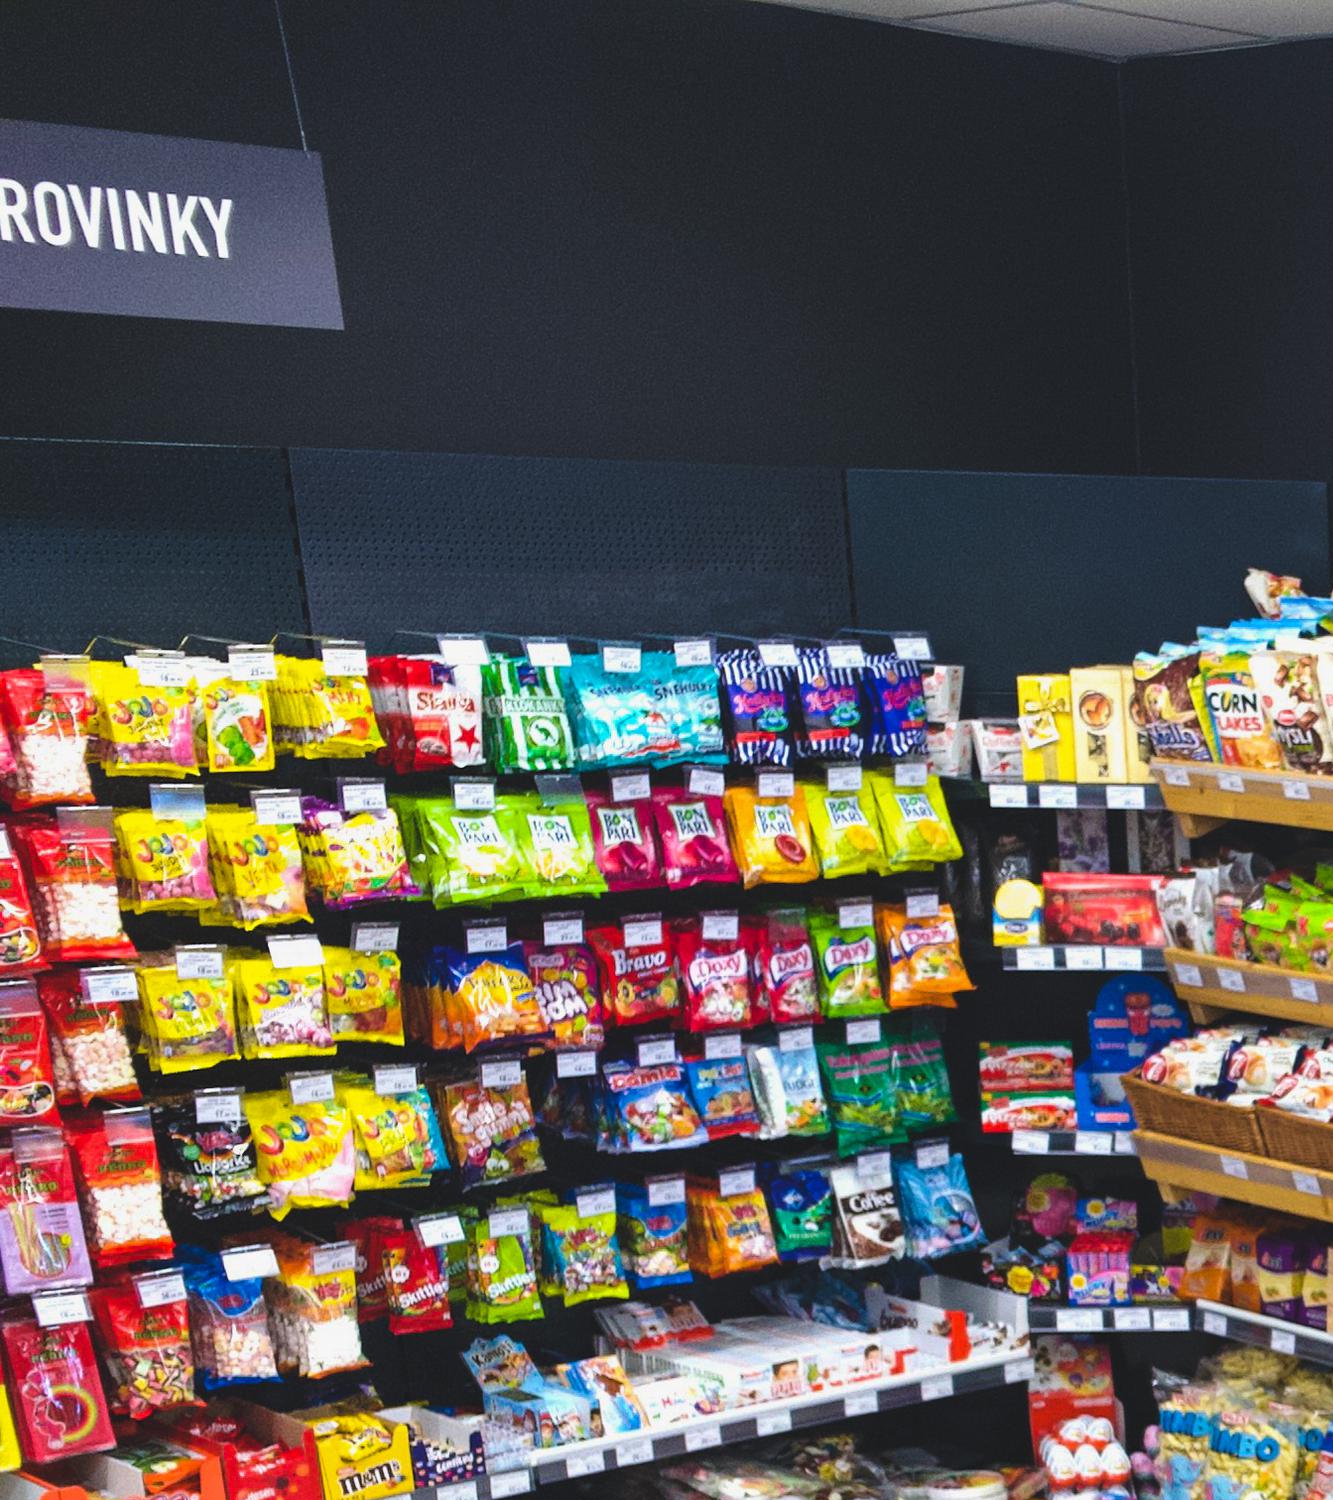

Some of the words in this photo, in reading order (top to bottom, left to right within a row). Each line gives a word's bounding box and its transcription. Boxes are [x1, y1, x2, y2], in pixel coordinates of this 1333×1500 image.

[0, 177, 233, 259] ROVINKY
[903, 926, 951, 948] Doxy
[613, 948, 666, 976] Bravo
[695, 956, 746, 983] Doxy
[849, 1190, 895, 1213] Coffee
